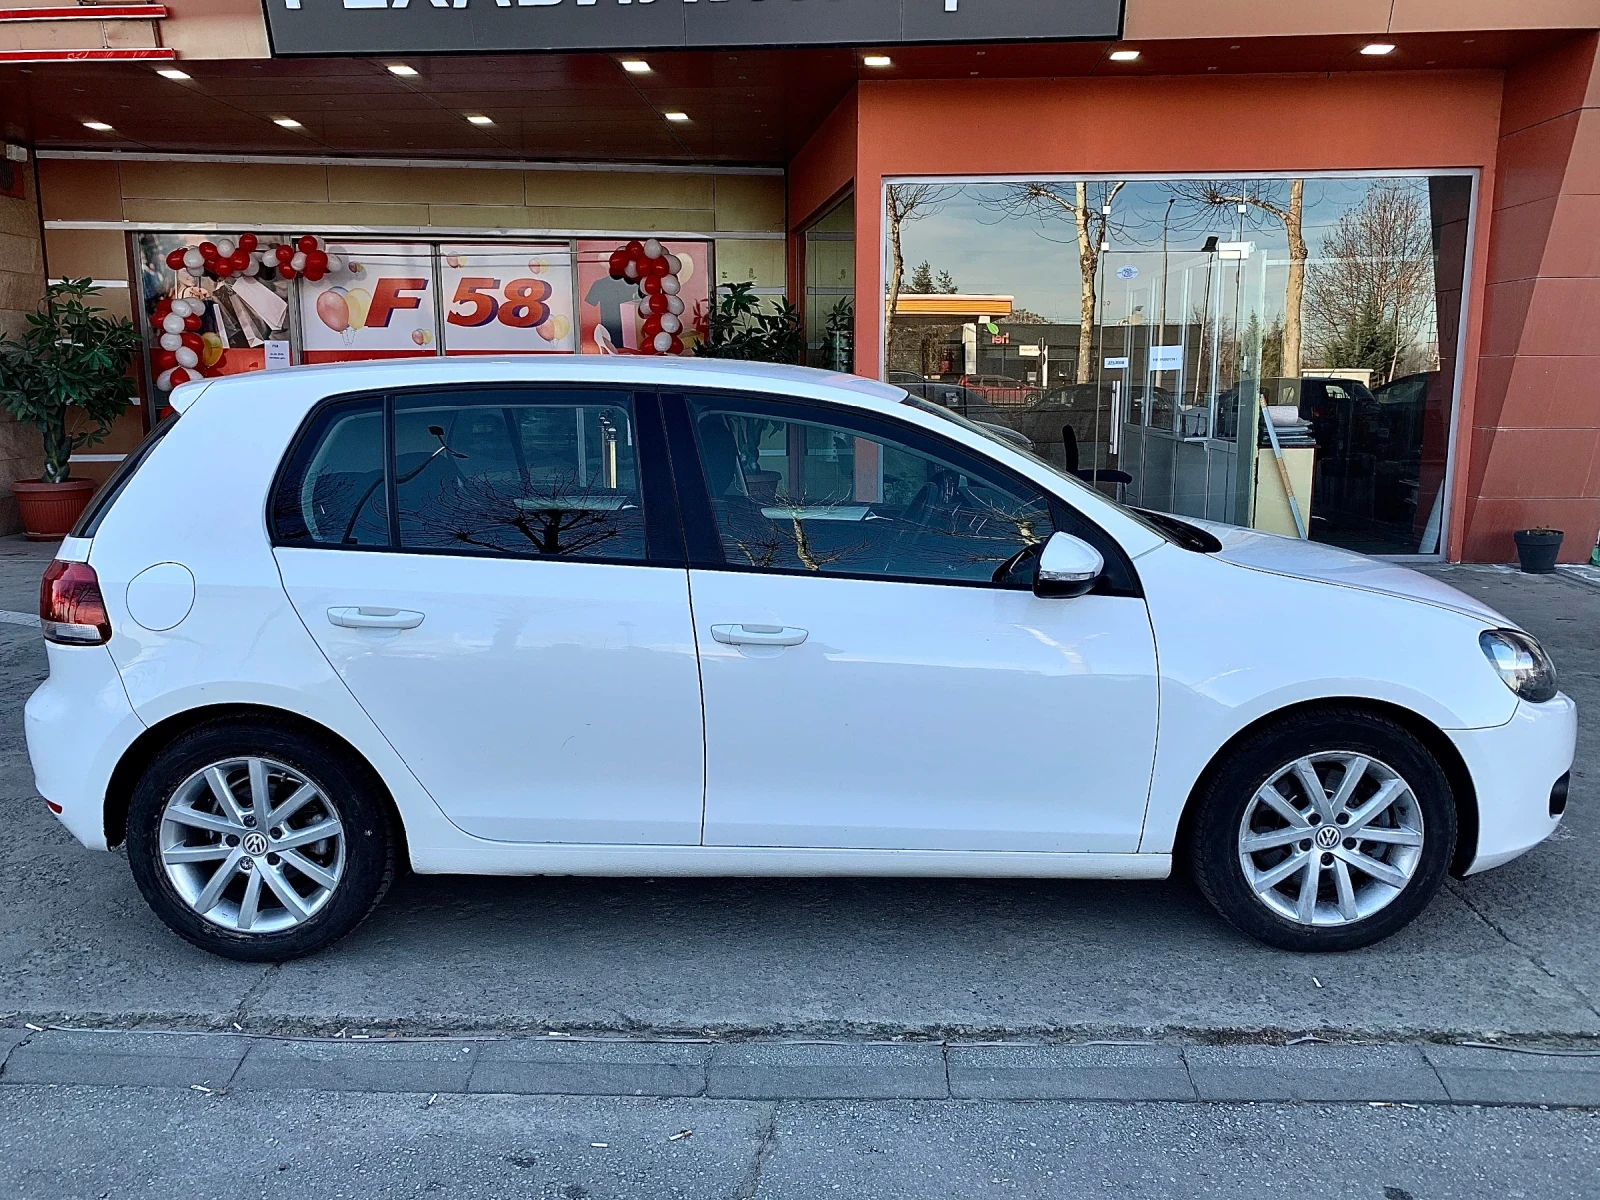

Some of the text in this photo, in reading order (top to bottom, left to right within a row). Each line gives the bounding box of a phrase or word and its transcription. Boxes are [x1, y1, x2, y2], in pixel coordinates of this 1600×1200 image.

[364, 277, 553, 328] F 58
[245, 833, 267, 855] VW
[1317, 826, 1340, 848] VW
